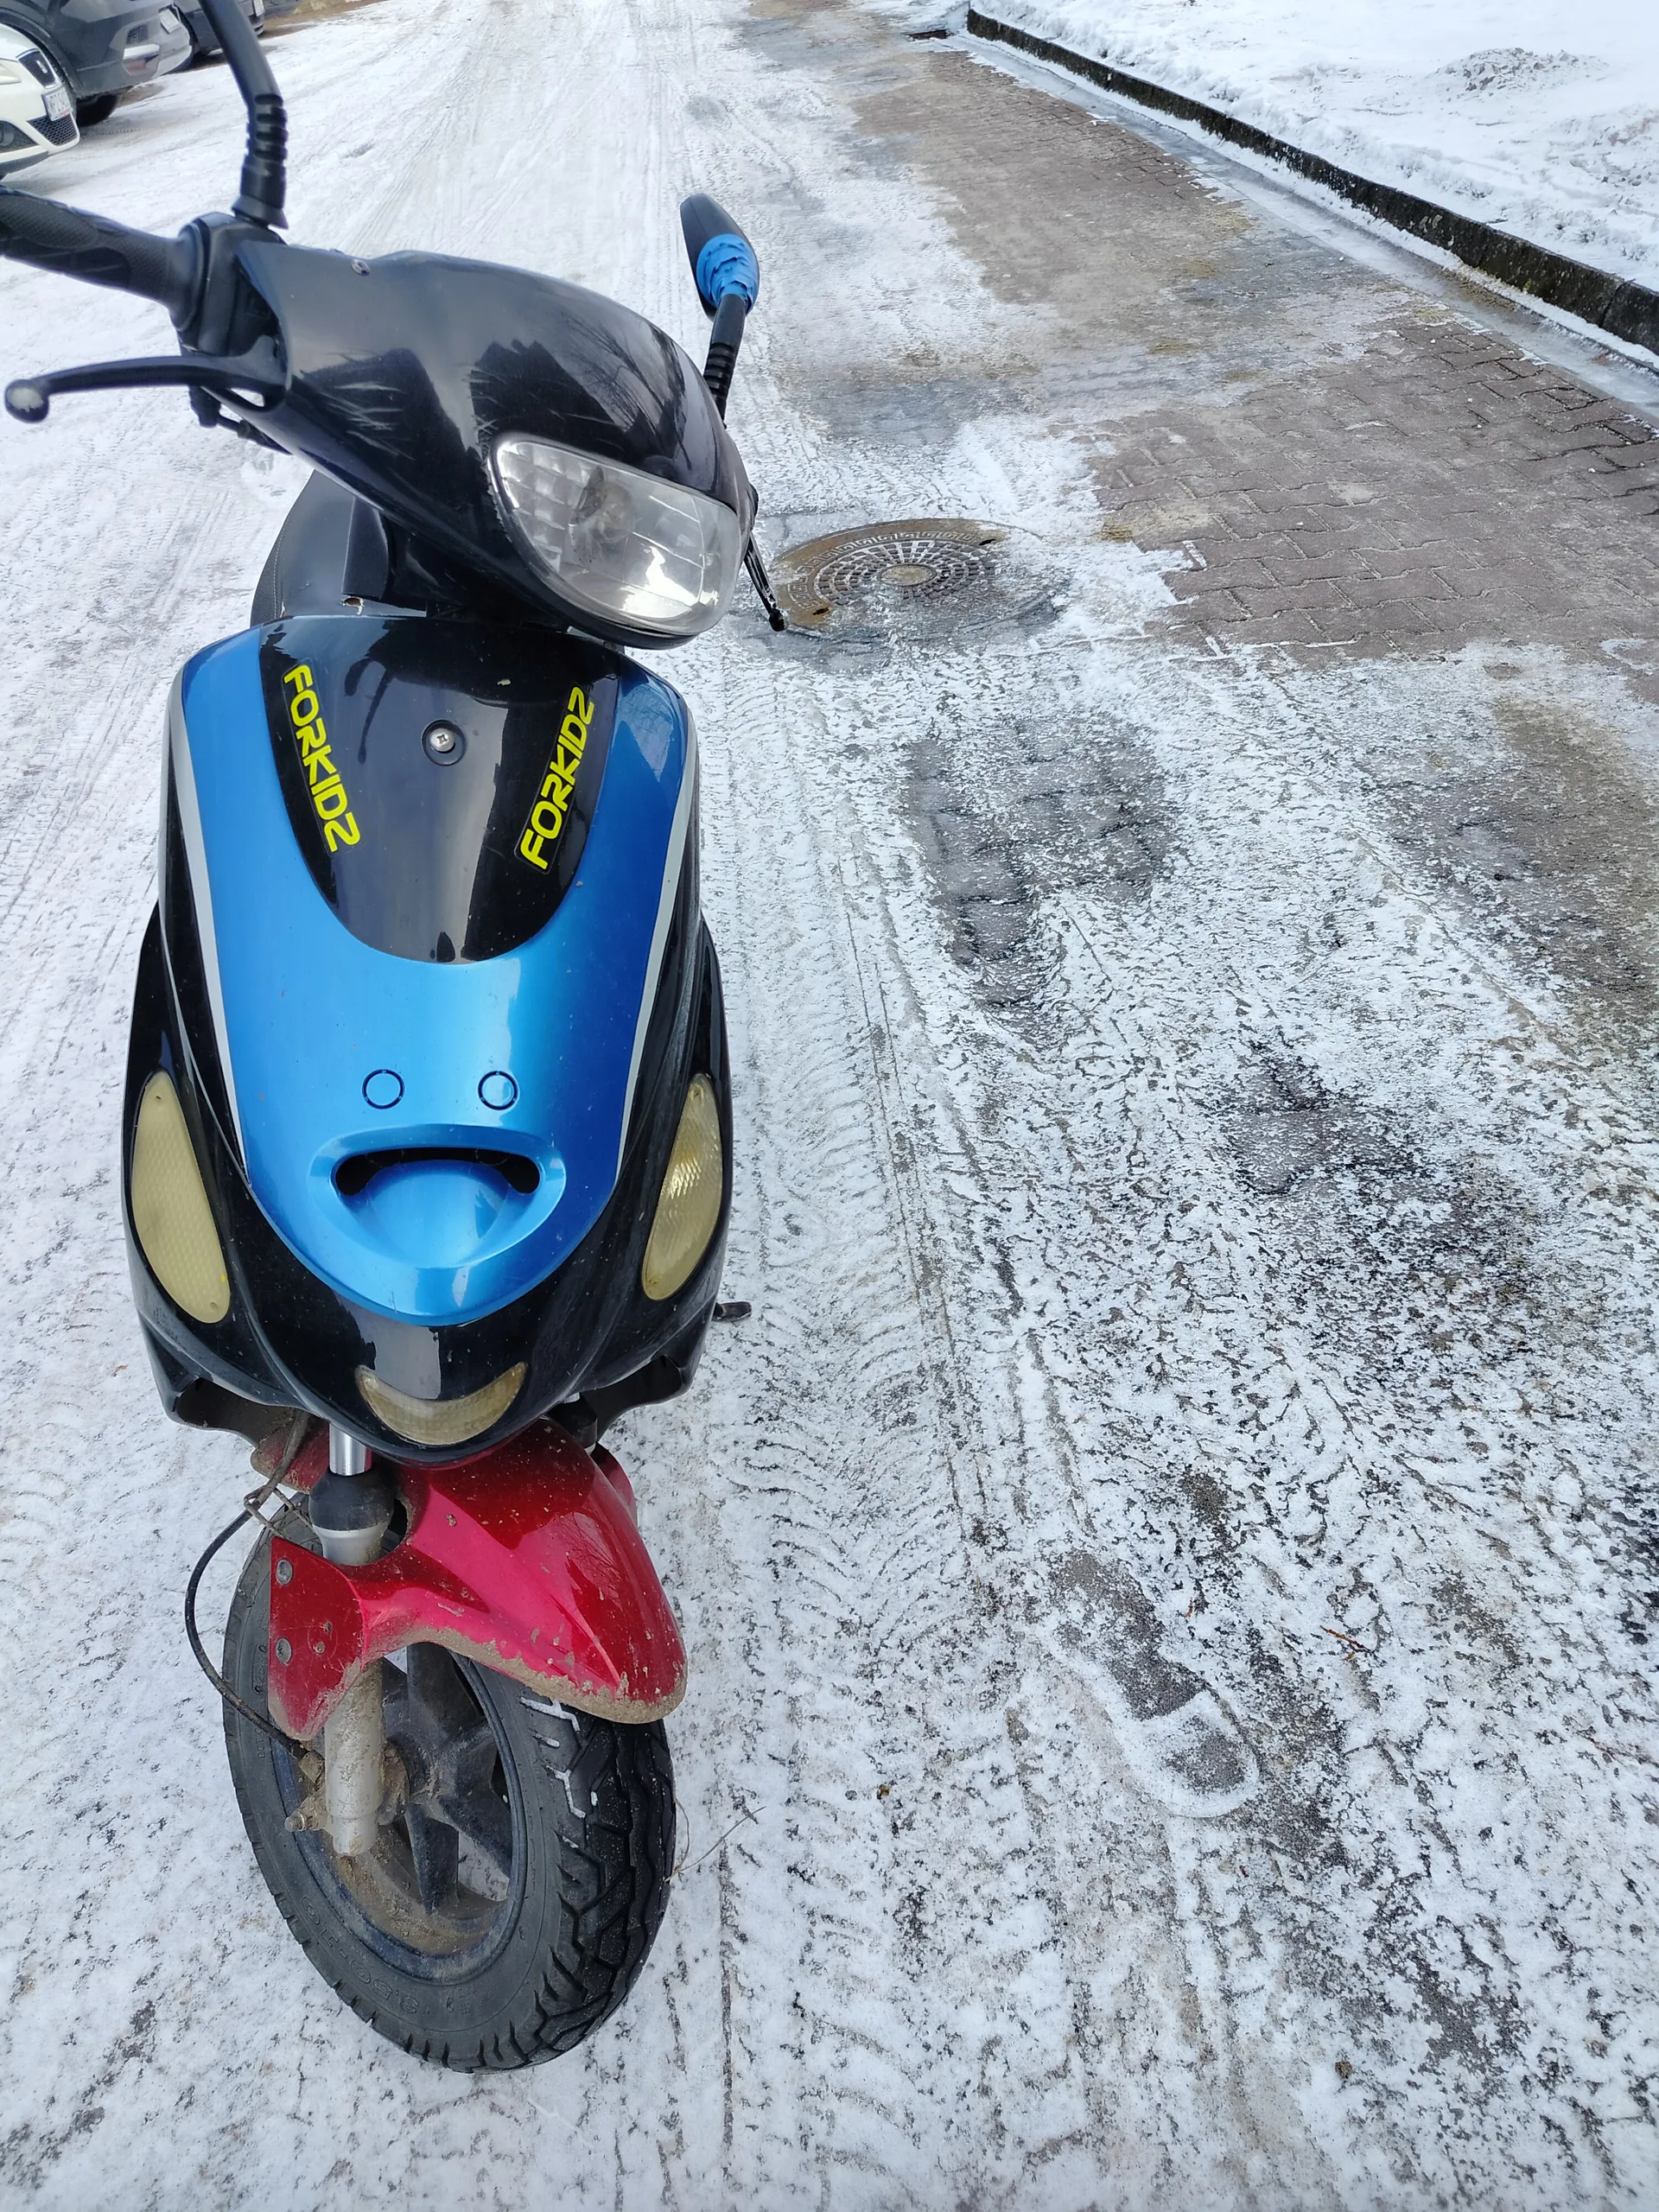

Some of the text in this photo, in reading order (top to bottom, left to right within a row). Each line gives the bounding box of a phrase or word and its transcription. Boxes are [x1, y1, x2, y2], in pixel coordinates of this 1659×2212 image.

[283, 664, 360, 851] FORKIDZ
[520, 686, 594, 869] FORKIDZ
[302, 1896, 420, 2014] 3.50-10
